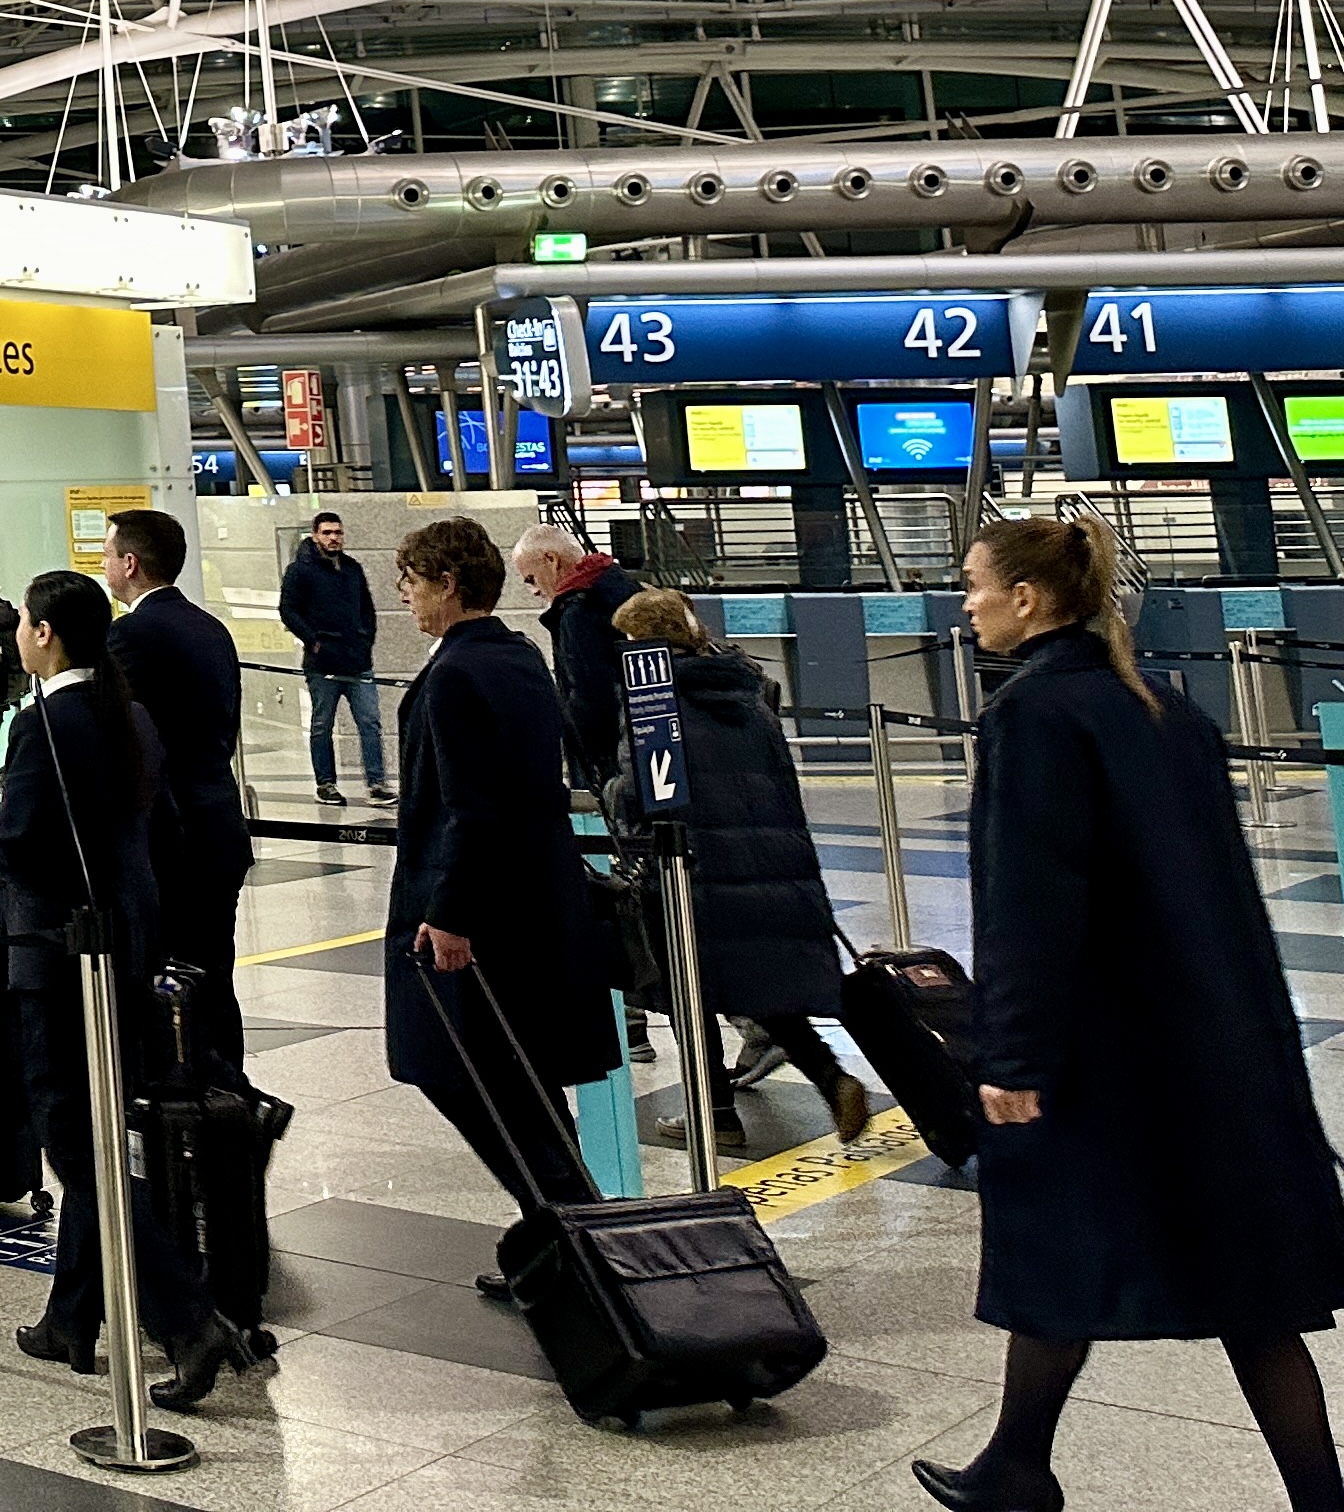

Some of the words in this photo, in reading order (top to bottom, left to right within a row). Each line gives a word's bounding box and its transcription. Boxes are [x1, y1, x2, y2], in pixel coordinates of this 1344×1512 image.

[600, 311, 676, 363] 43
[903, 306, 982, 359] 42
[1088, 302, 1157, 352] 41
[511, 359, 533, 398] 31
[538, 359, 561, 398] 43
[192, 454, 219, 474] 54
[742, 1167, 834, 1208] penas
